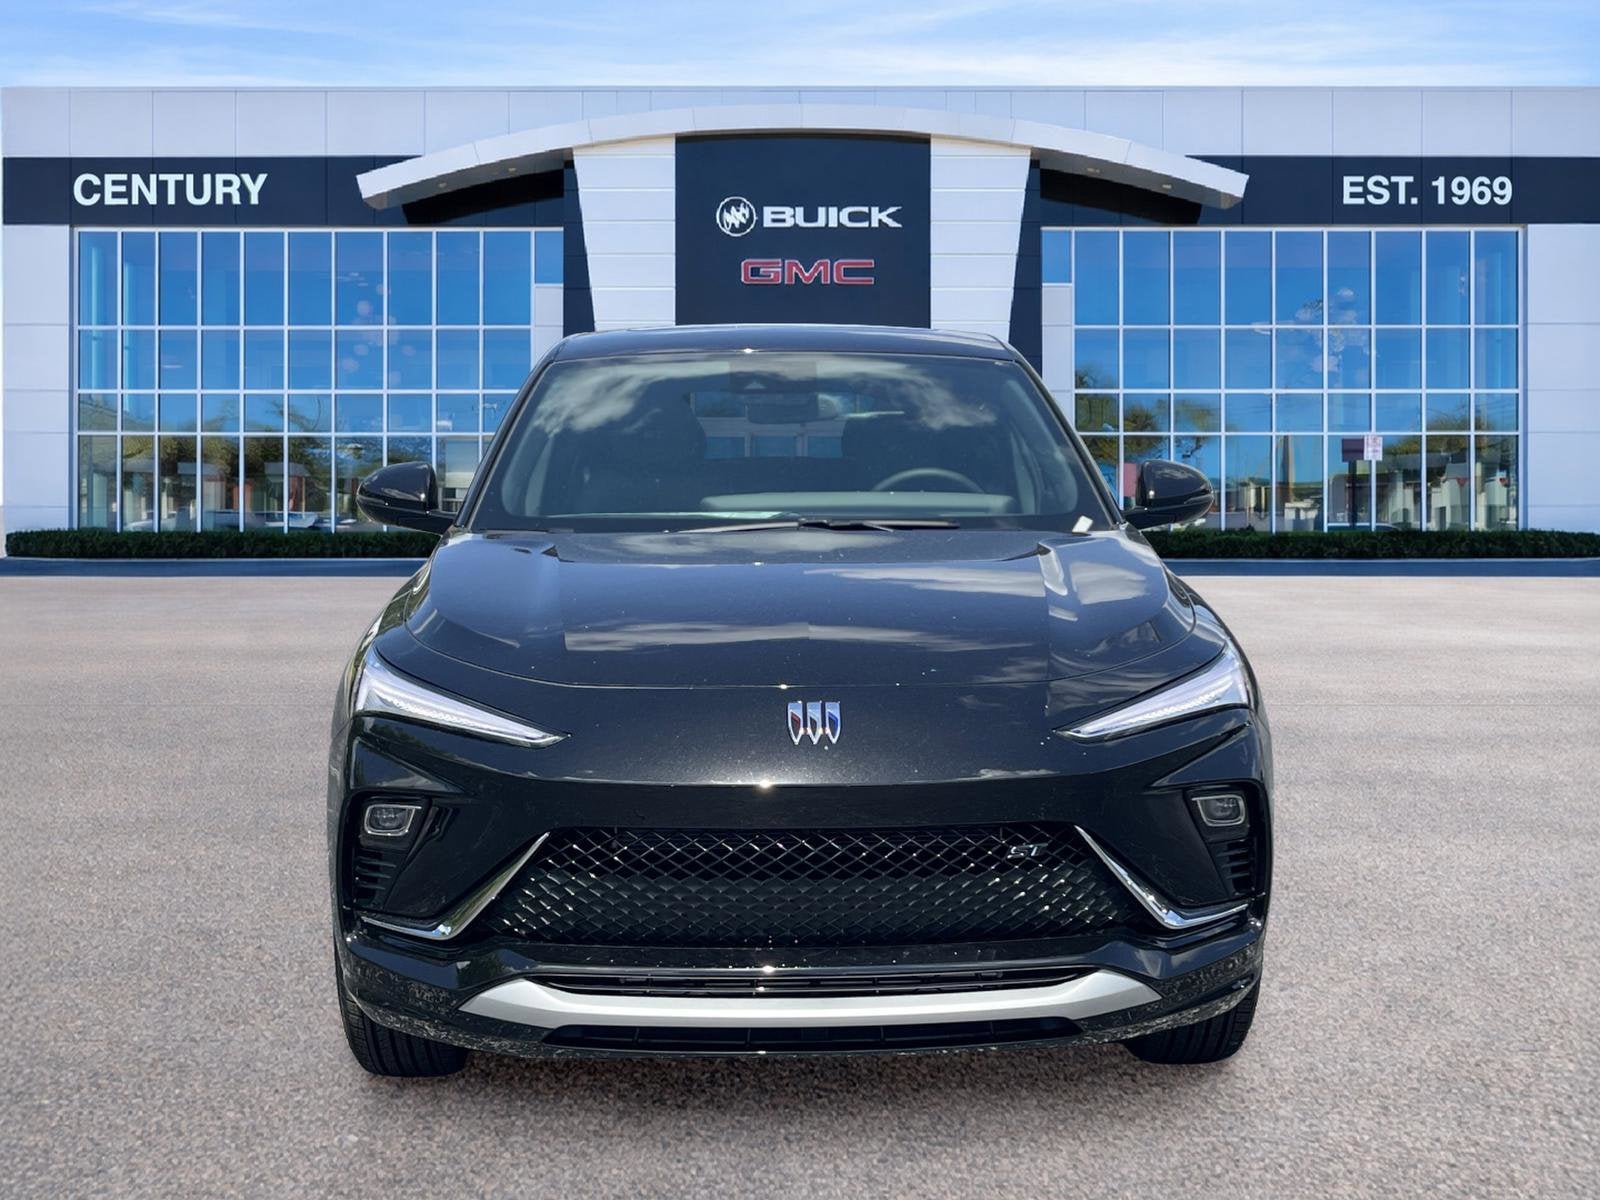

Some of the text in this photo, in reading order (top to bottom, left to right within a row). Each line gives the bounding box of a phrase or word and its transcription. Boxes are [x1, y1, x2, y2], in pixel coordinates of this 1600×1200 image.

[73, 173, 268, 206] CENTURY
[1342, 175, 1513, 206] EST. 1969
[763, 206, 903, 228] BUICK
[740, 258, 875, 285] GMC
[1007, 843, 1049, 859] ST
